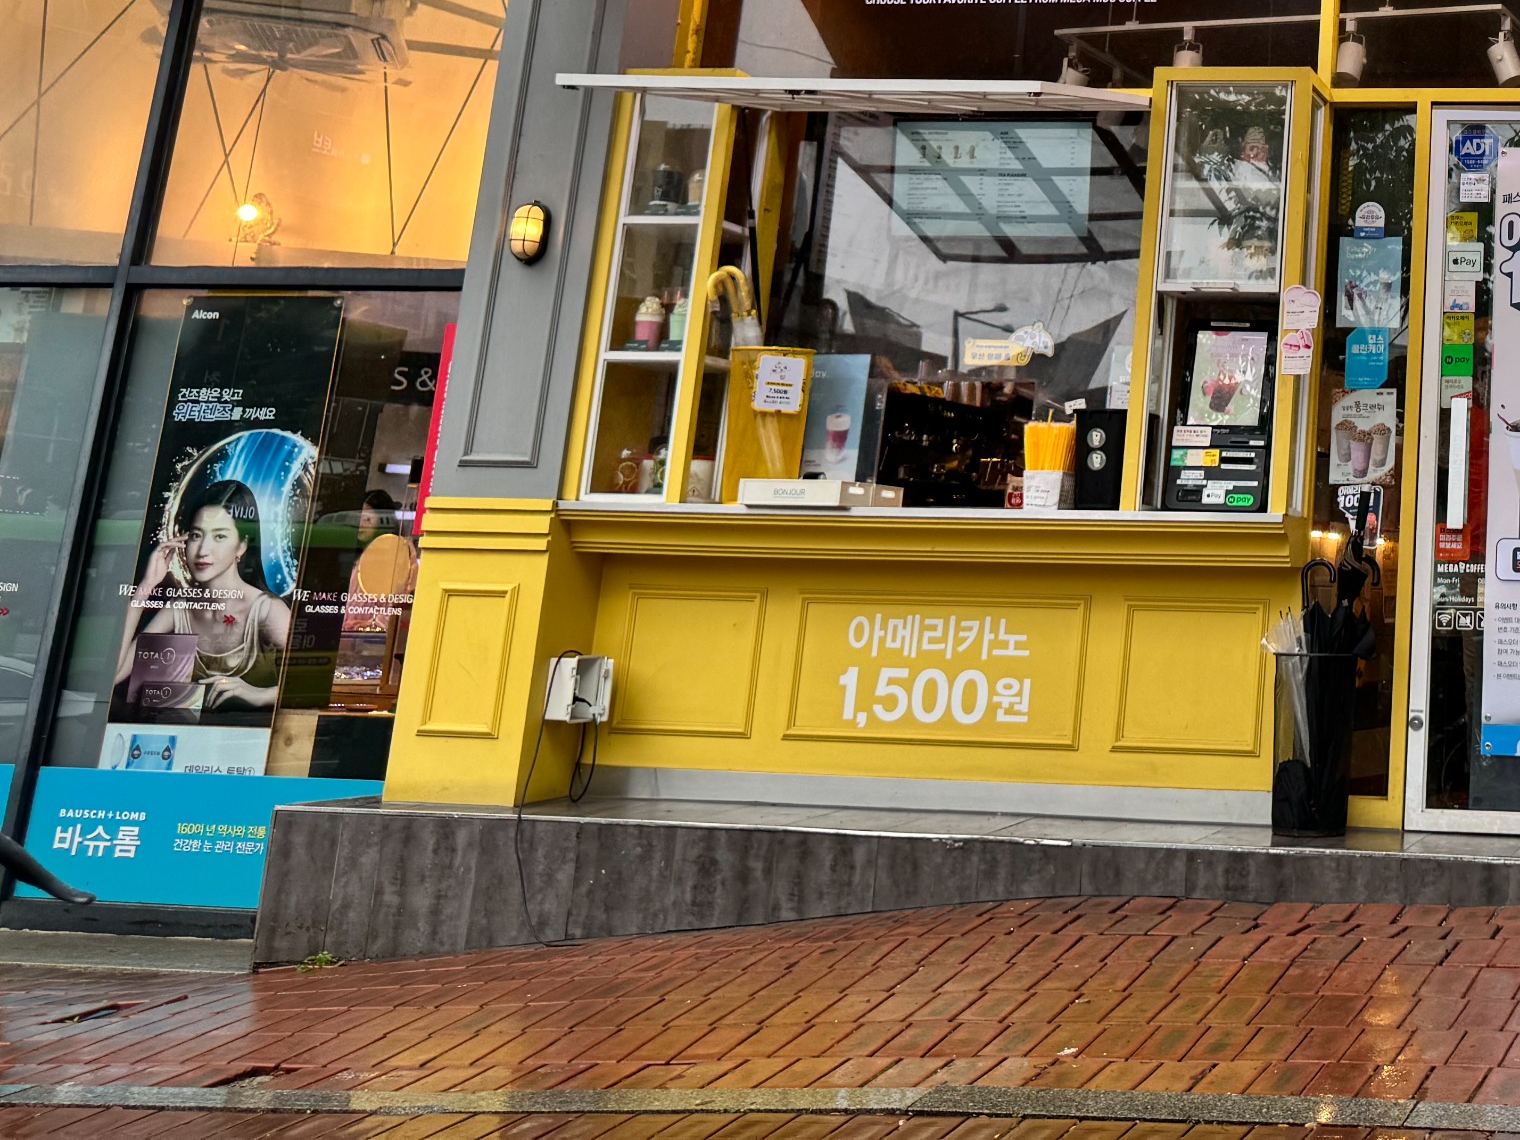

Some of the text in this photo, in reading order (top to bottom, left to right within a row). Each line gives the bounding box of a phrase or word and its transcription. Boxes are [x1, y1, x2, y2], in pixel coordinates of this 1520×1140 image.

[1461, 138, 1494, 156] ADT
[1459, 256, 1477, 267] Pay
[192, 310, 220, 319] Alcon
[178, 388, 243, 401] 건조함은 잊고
[773, 487, 806, 497] BONJOUR
[1437, 563, 1458, 573] MEGA
[118, 584, 136, 597] WE
[139, 586, 163, 597] MAKE
[166, 586, 202, 598] GLASSES
[212, 588, 244, 599] DESIGN
[292, 589, 311, 601] WE
[340, 592, 378, 603] GLASSES
[131, 600, 164, 609] GLASSES
[173, 600, 226, 610] CONTACTLENS
[305, 605, 339, 614] GLASSES
[348, 606, 403, 615] CONTACTLENS
[848, 614, 1030, 661] 아메리카노
[839, 666, 1031, 729] 1,500원
[59, 808, 147, 821] BAUSCH+LOMB
[177, 822, 268, 839] 160여 년 역사와 전통
[52, 823, 141, 858] 바슈롬
[173, 838, 265, 855] 건강한 눈 관리 전문가
